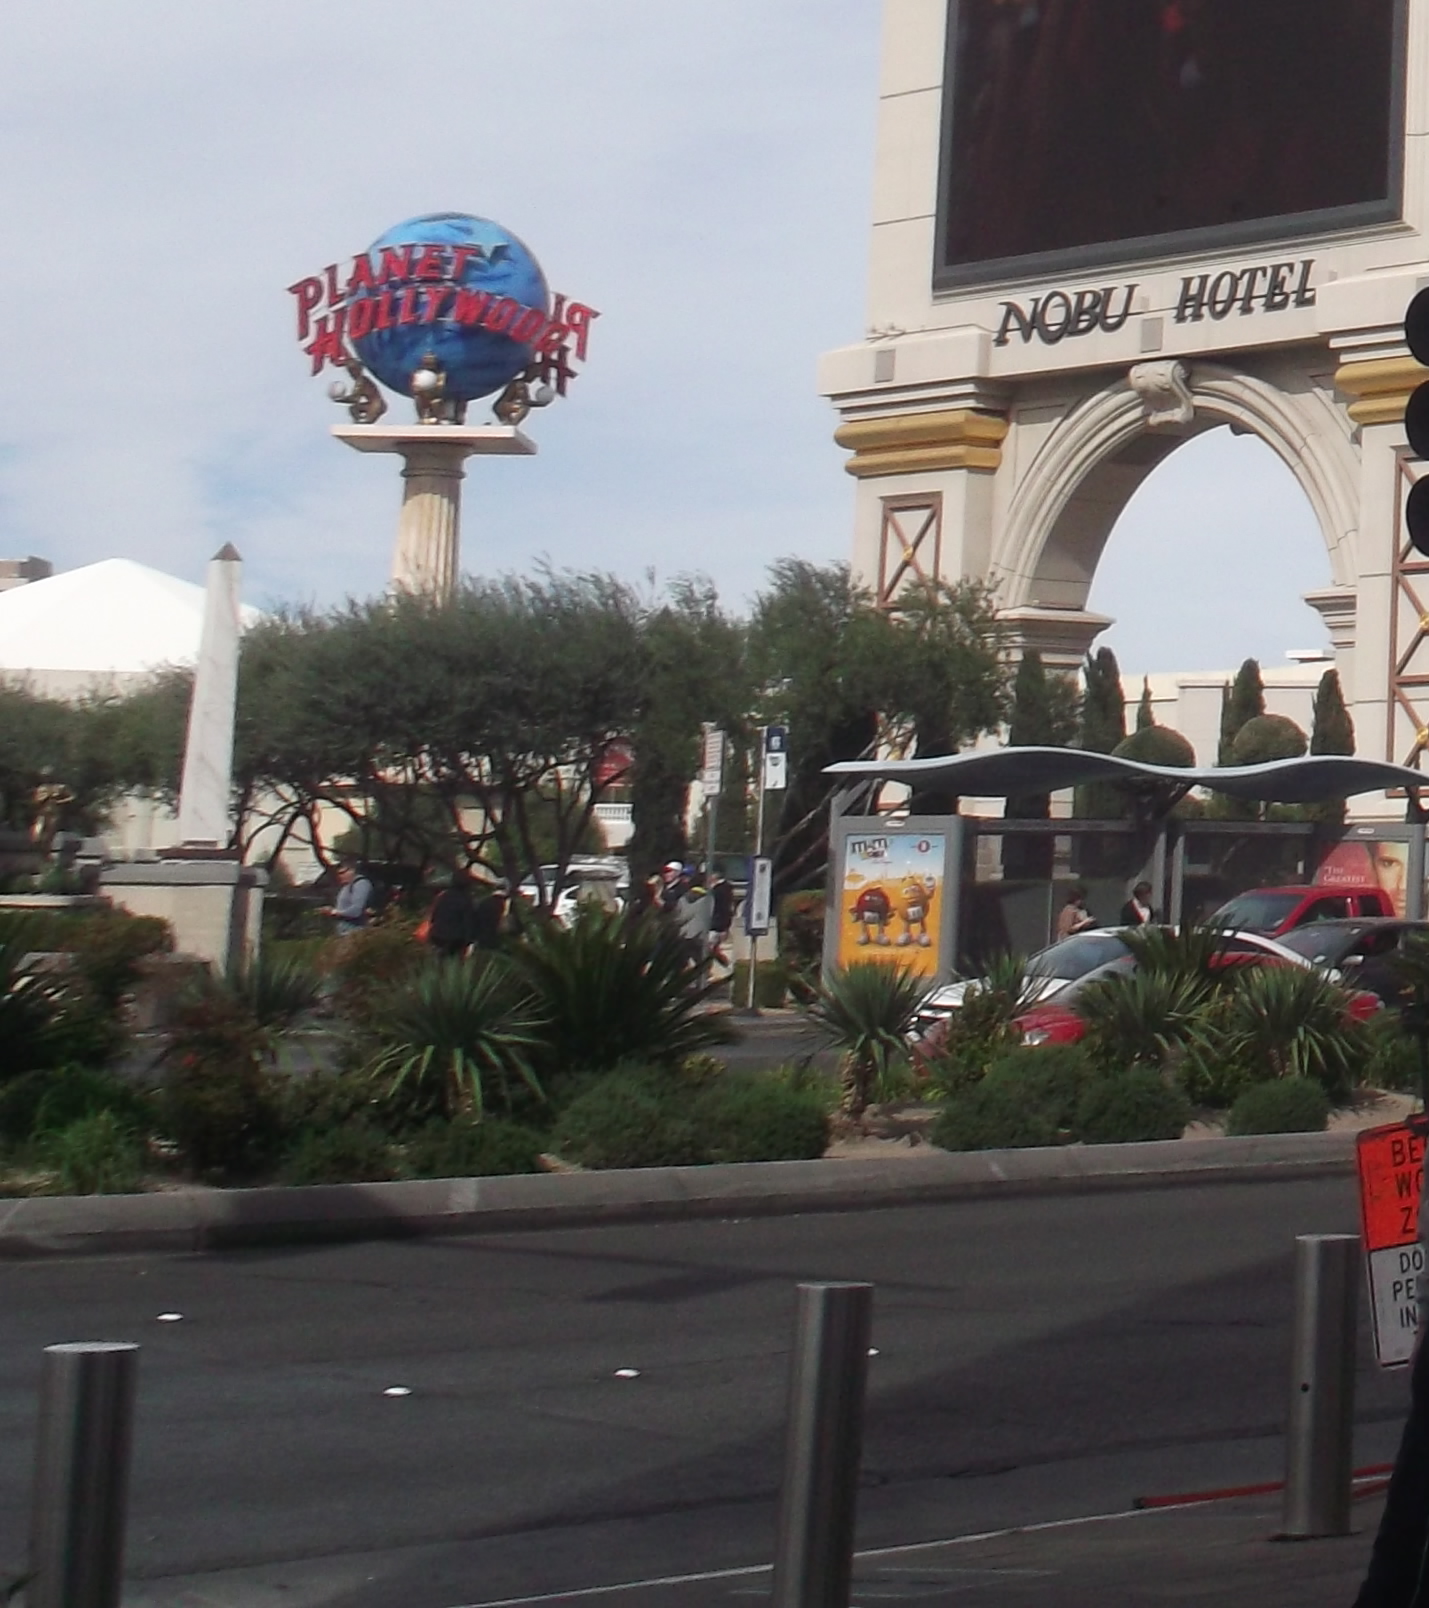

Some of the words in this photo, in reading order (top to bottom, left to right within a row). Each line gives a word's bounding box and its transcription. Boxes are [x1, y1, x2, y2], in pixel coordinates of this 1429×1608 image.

[285, 243, 480, 342] PLANET
[303, 285, 571, 377] HOLLYWOOD
[993, 283, 1141, 347] NOBU
[1173, 259, 1317, 324] HOTEL
[1391, 1138, 1424, 1168] BE
[1393, 1278, 1415, 1303] PE
